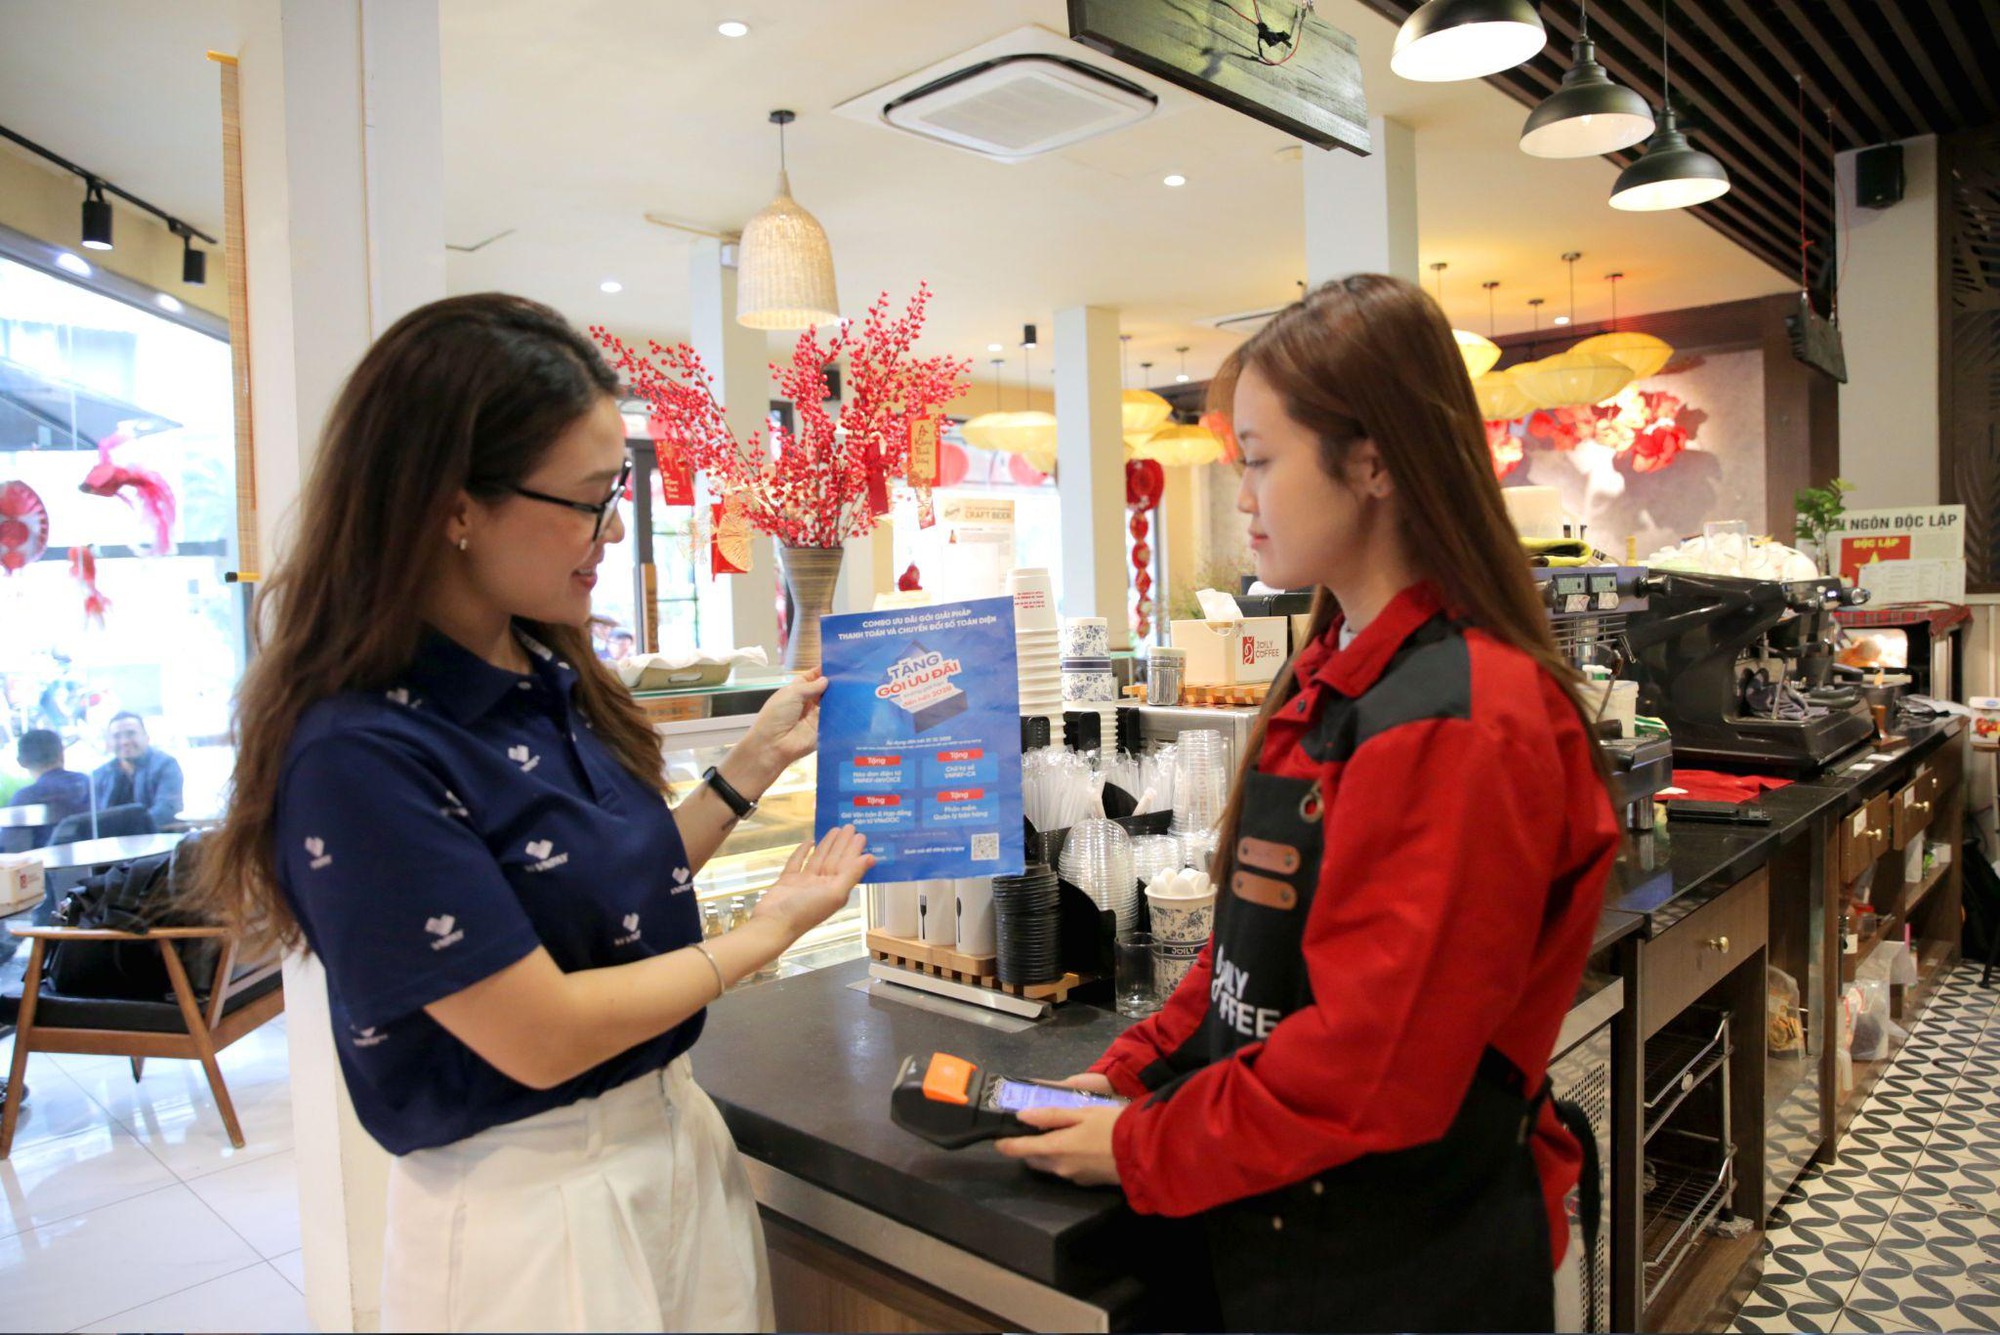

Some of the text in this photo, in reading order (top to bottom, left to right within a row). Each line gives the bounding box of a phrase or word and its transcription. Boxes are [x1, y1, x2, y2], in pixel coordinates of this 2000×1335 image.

[1851, 514, 1890, 530] NGÔN
[1894, 514, 1924, 531] ĐỘC
[1929, 512, 1958, 530] LẬP
[1853, 537, 1900, 549] ĐỘC LẬP
[862, 618, 892, 628] COMBO
[837, 632, 864, 641] THANH
[1255, 648, 1280, 659] COFFEE
[877, 681, 907, 697] GÓI
[931, 661, 958, 679] ĐÃI
